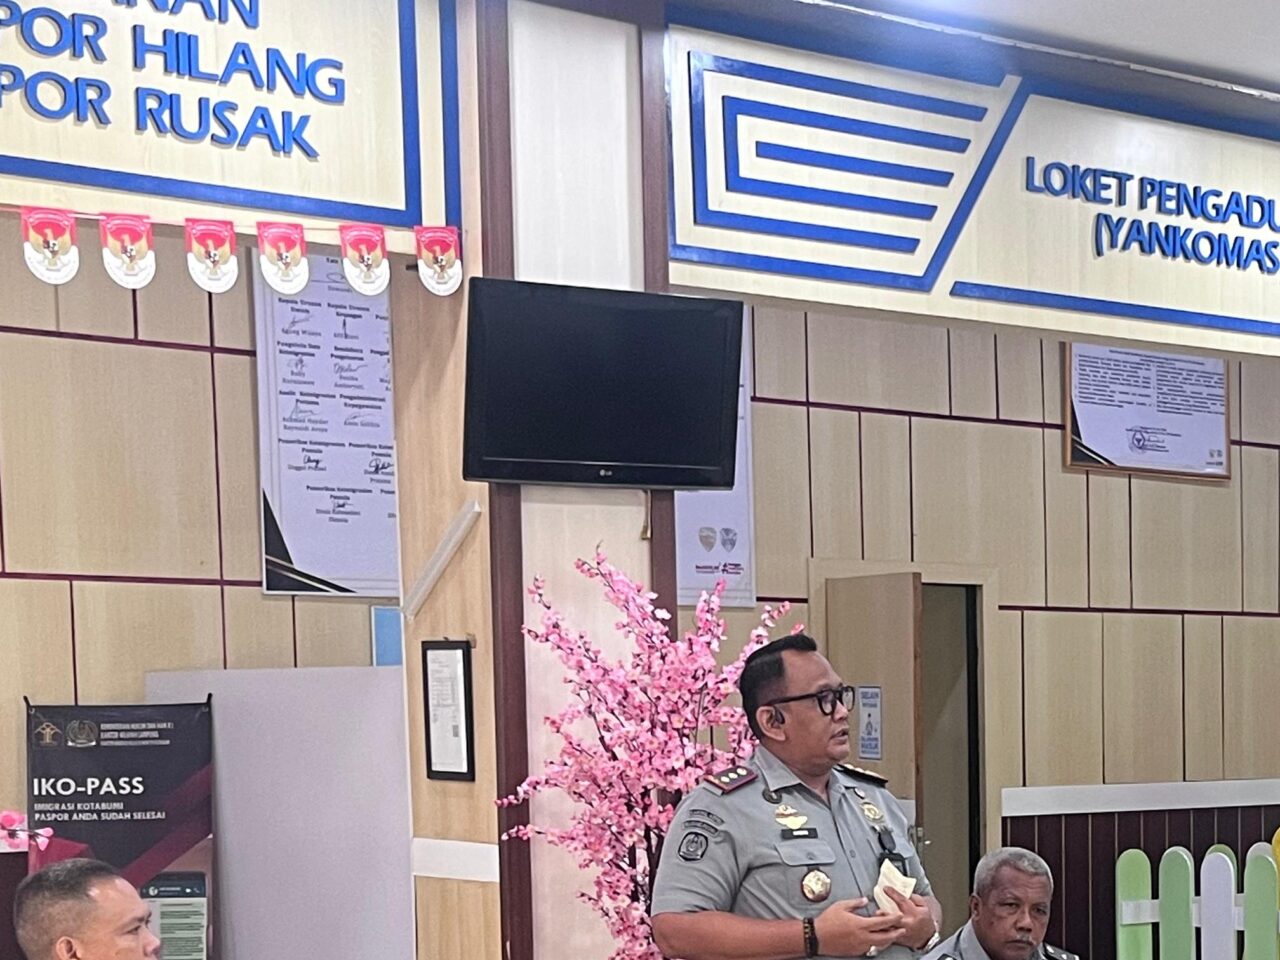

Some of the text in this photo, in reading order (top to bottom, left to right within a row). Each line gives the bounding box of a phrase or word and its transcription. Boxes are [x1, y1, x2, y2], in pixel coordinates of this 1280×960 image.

[133, 24, 345, 104] HILANG
[136, 87, 319, 159] RUSAK
[1026, 156, 1133, 206] LOKET
[33, 777, 145, 796] IKO-PASS
[34, 802, 124, 811] IMIGRASI KOTABUMI
[34, 811, 166, 821] PASPOR ANDA SUDAH SELESAI
